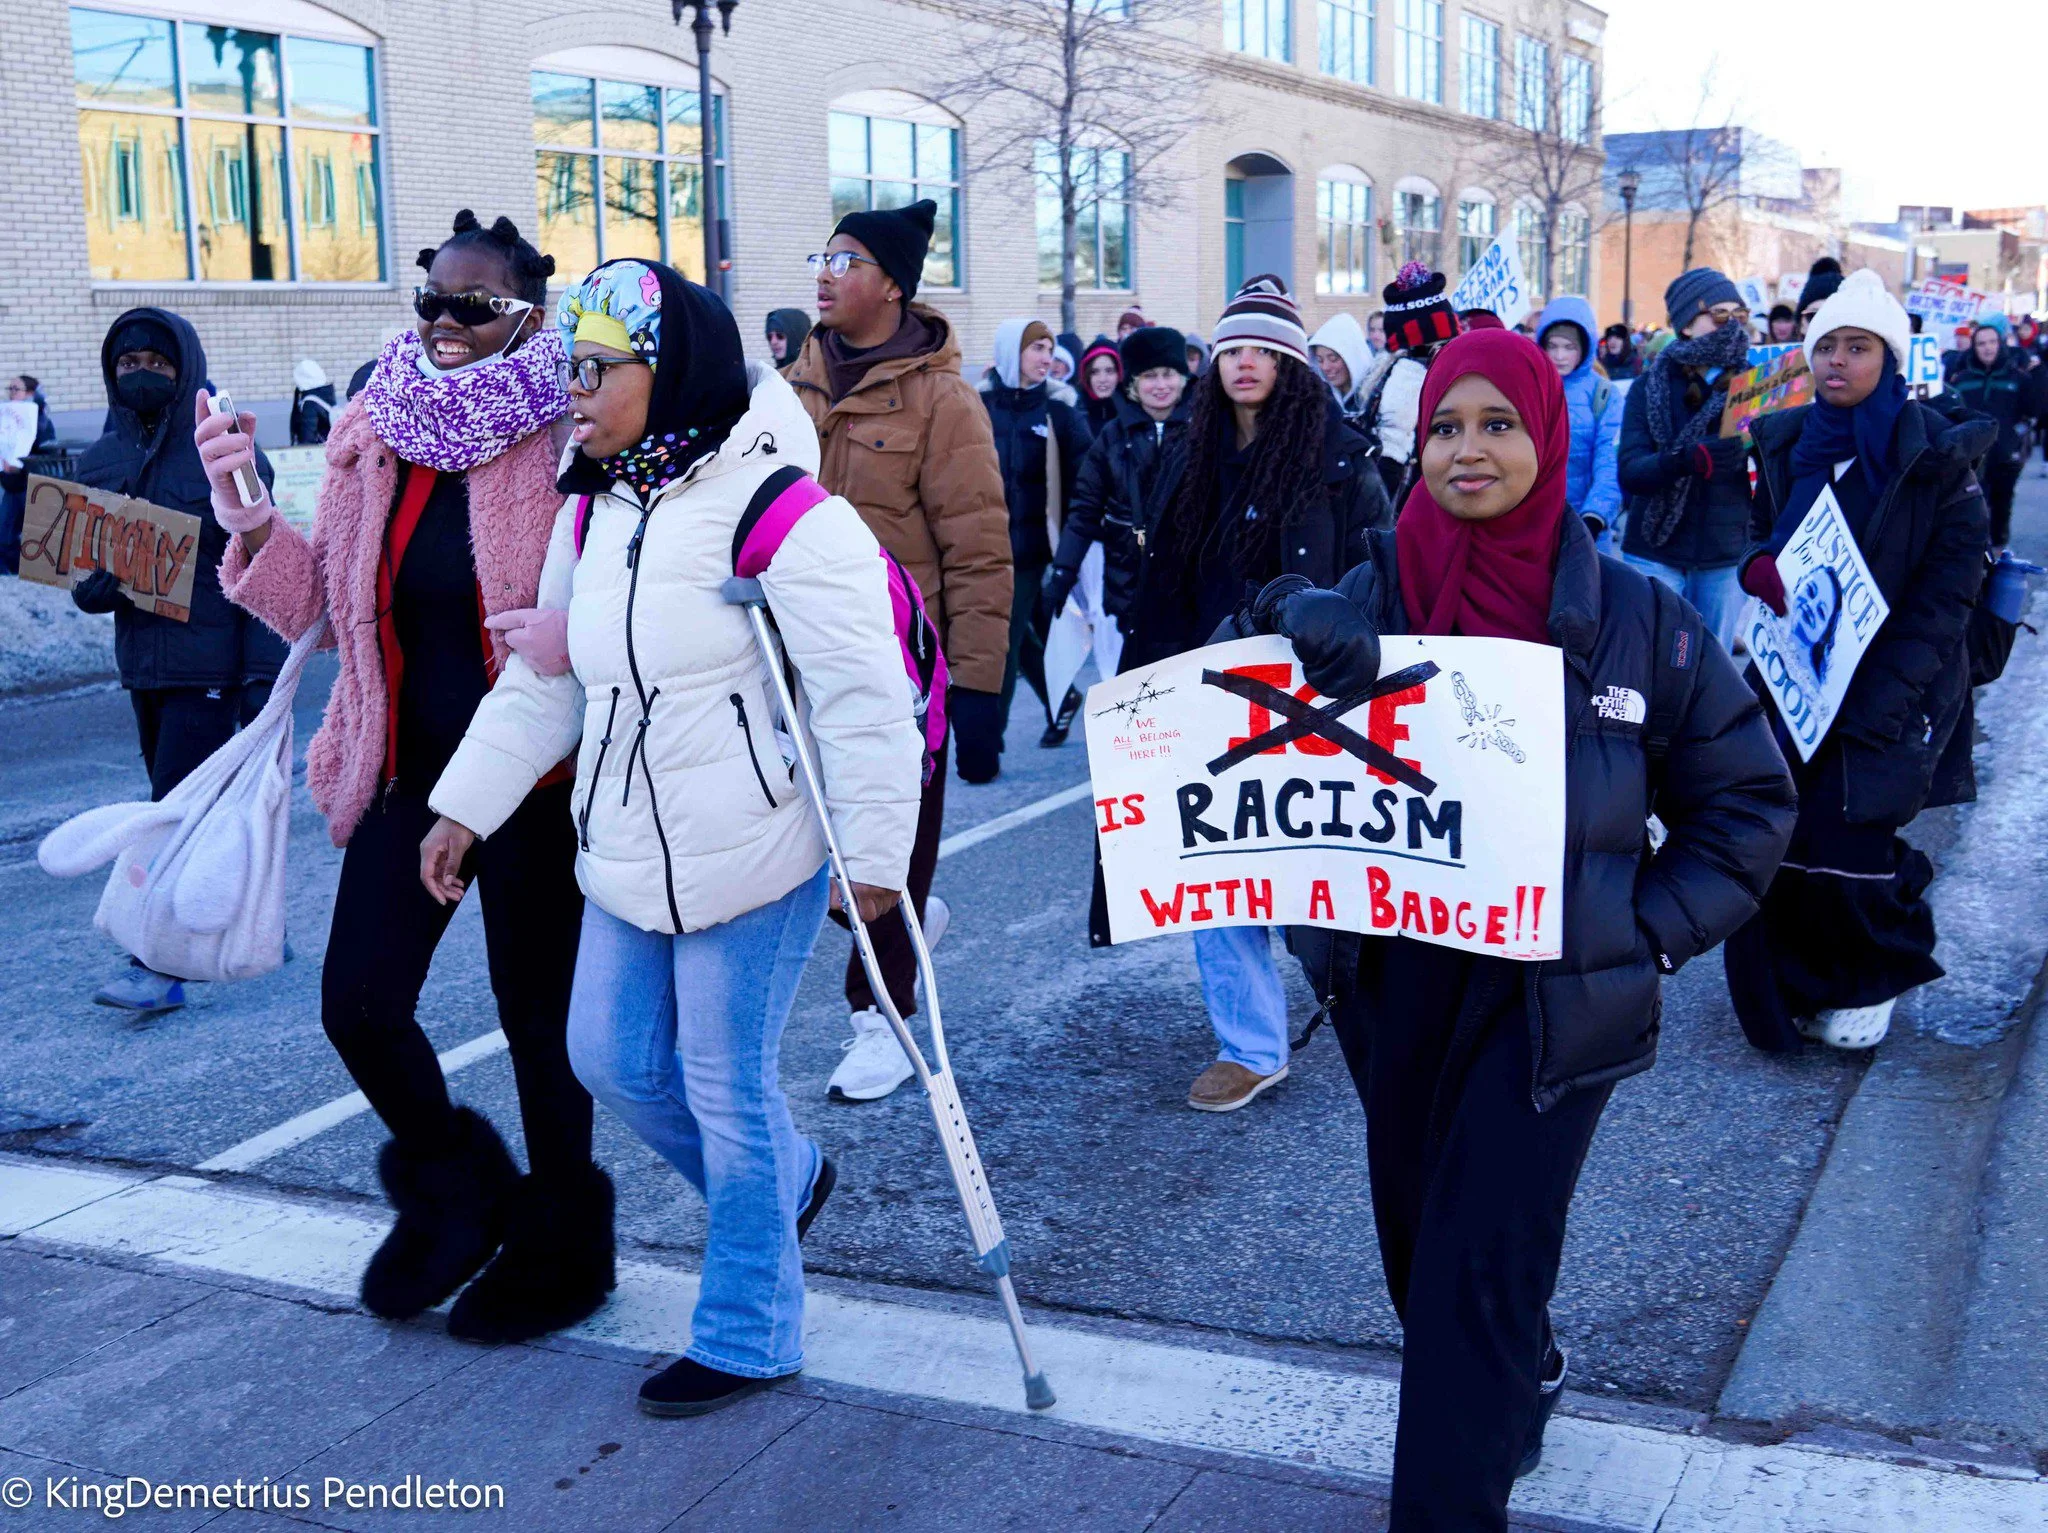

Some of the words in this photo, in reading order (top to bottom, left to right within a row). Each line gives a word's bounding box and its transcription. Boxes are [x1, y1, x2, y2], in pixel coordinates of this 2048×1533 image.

[1452, 244, 1501, 312] DEFEND
[21, 482, 67, 567] 2
[1790, 536, 1815, 567] for
[1805, 502, 1880, 643] JUSTICE
[1598, 706, 1629, 721] FACE
[1606, 685, 1629, 699] THE
[1752, 622, 1818, 745] GOOD
[1113, 735, 1133, 745] ALL
[1139, 729, 1181, 743] BELONG
[1136, 717, 1157, 729] WE
[1096, 793, 1146, 834] IS
[1176, 777, 1463, 860] RACISM
[1139, 877, 1273, 928] WITH
[1308, 879, 1336, 921] A
[1366, 865, 1547, 946] BADGE!!
